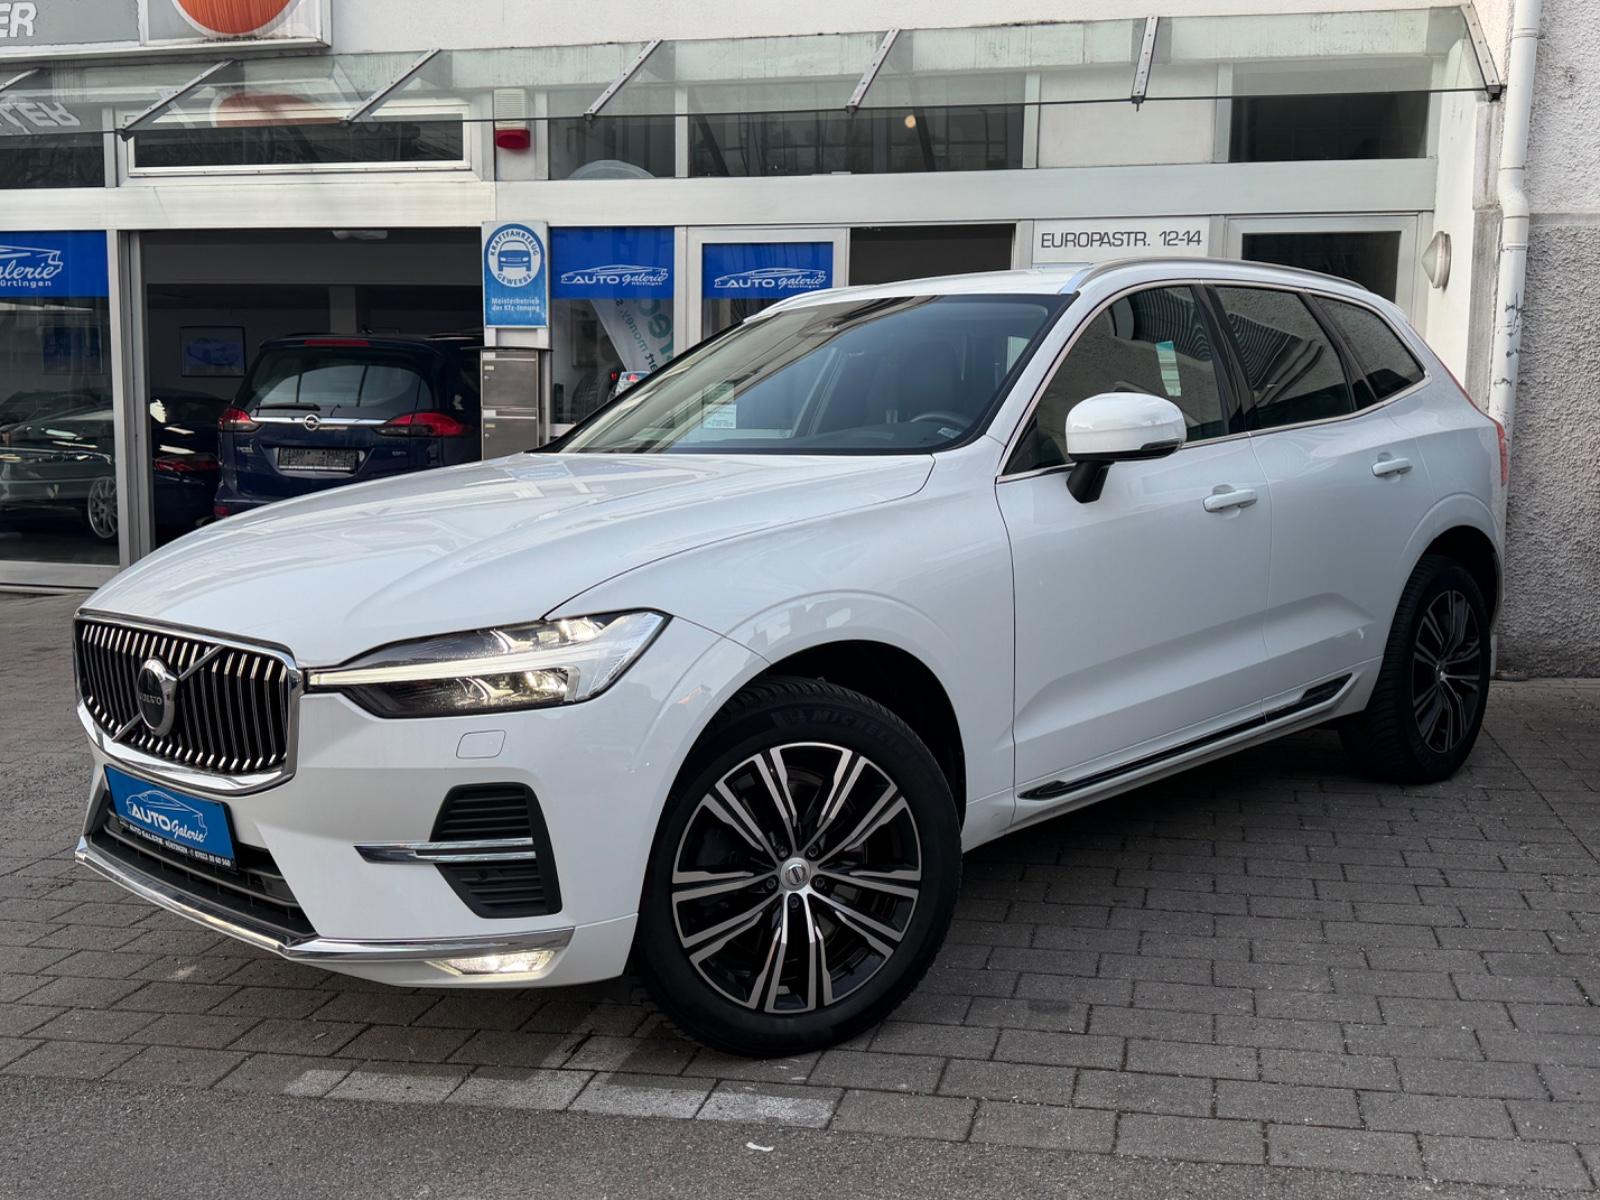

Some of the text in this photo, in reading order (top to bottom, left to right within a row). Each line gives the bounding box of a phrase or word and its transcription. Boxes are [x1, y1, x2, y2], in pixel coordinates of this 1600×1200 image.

[490, 230, 540, 256] KRAFTFAHRZEUG
[1041, 230, 1202, 248] EUROPASTR. 12-14
[0, 259, 58, 279] lerie
[497, 273, 532, 286] GEWERBE
[573, 275, 620, 285] AUTO
[727, 279, 776, 288] AUTO
[132, 803, 170, 831] AUTO
